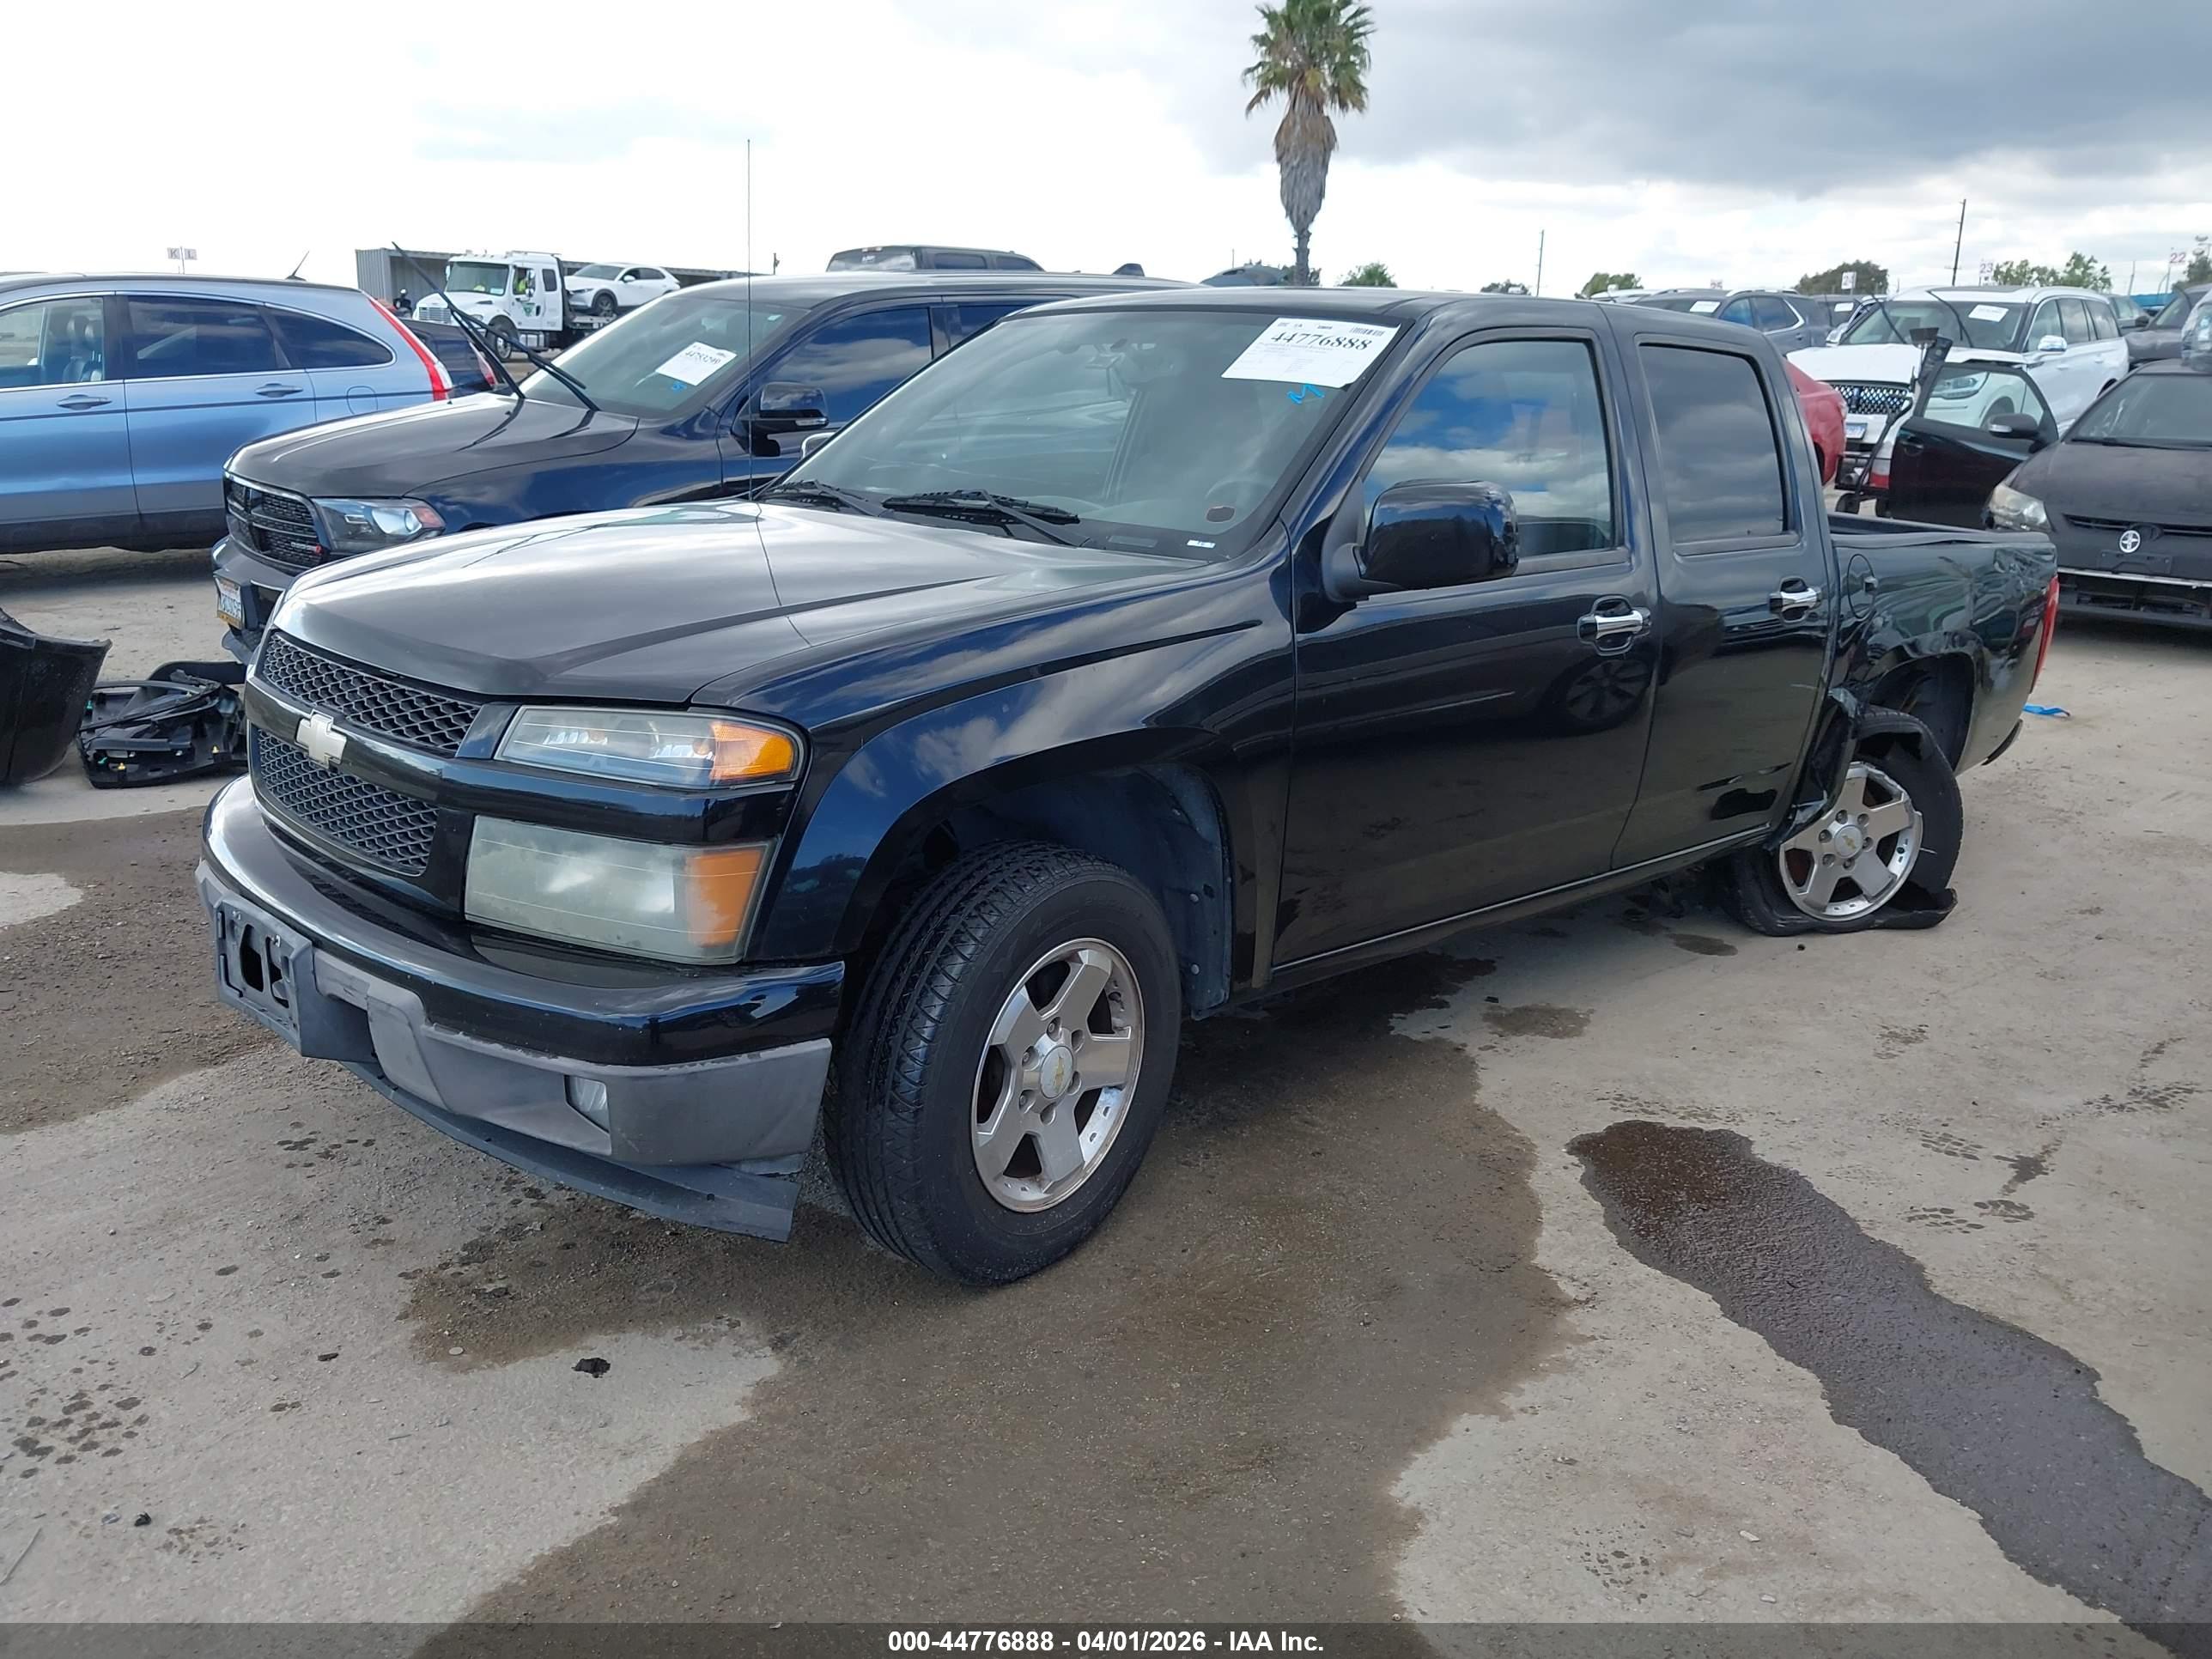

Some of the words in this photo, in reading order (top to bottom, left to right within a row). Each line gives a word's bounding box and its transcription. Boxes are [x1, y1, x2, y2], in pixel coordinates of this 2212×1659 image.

[170, 249, 179, 259] K
[2170, 252, 2186, 264] 22
[1979, 264, 1993, 273] 23
[1270, 331, 1373, 351] 44776888
